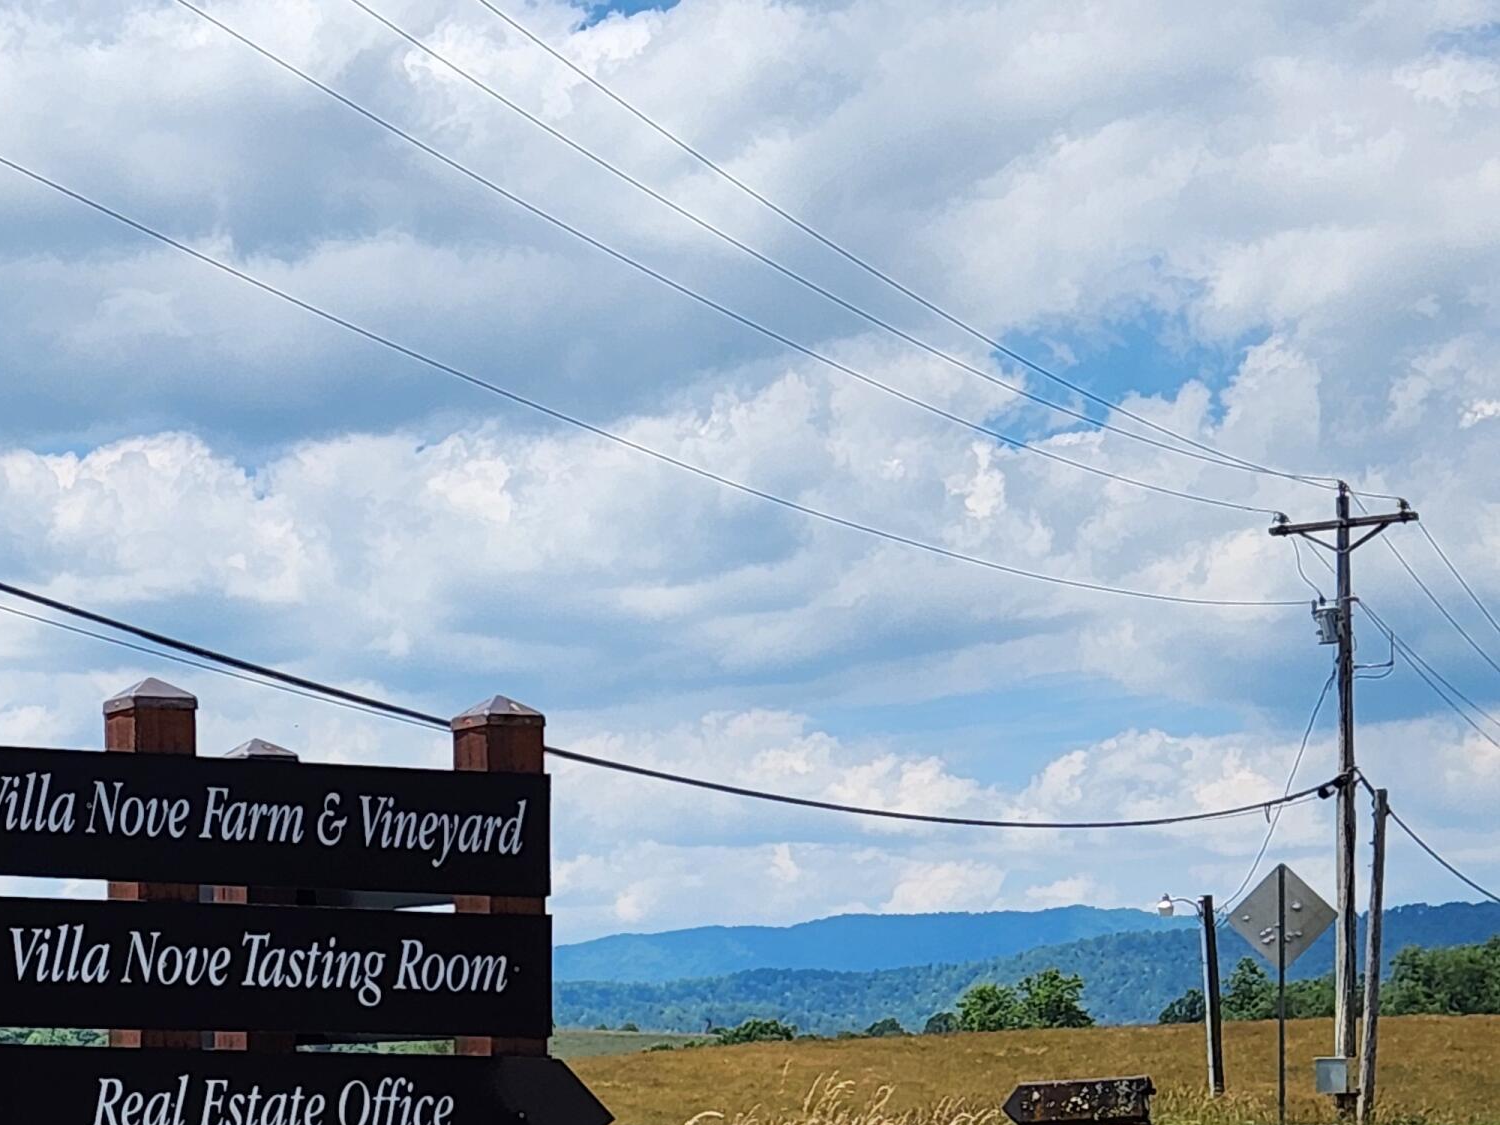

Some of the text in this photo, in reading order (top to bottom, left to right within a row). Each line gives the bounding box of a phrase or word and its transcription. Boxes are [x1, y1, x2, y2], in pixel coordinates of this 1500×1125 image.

[86, 781, 190, 839] Nove
[198, 786, 304, 844] Farm
[317, 792, 348, 846] &
[359, 796, 528, 868] Vineyard
[9, 923, 508, 1007] Villa Nove Tasting Room
